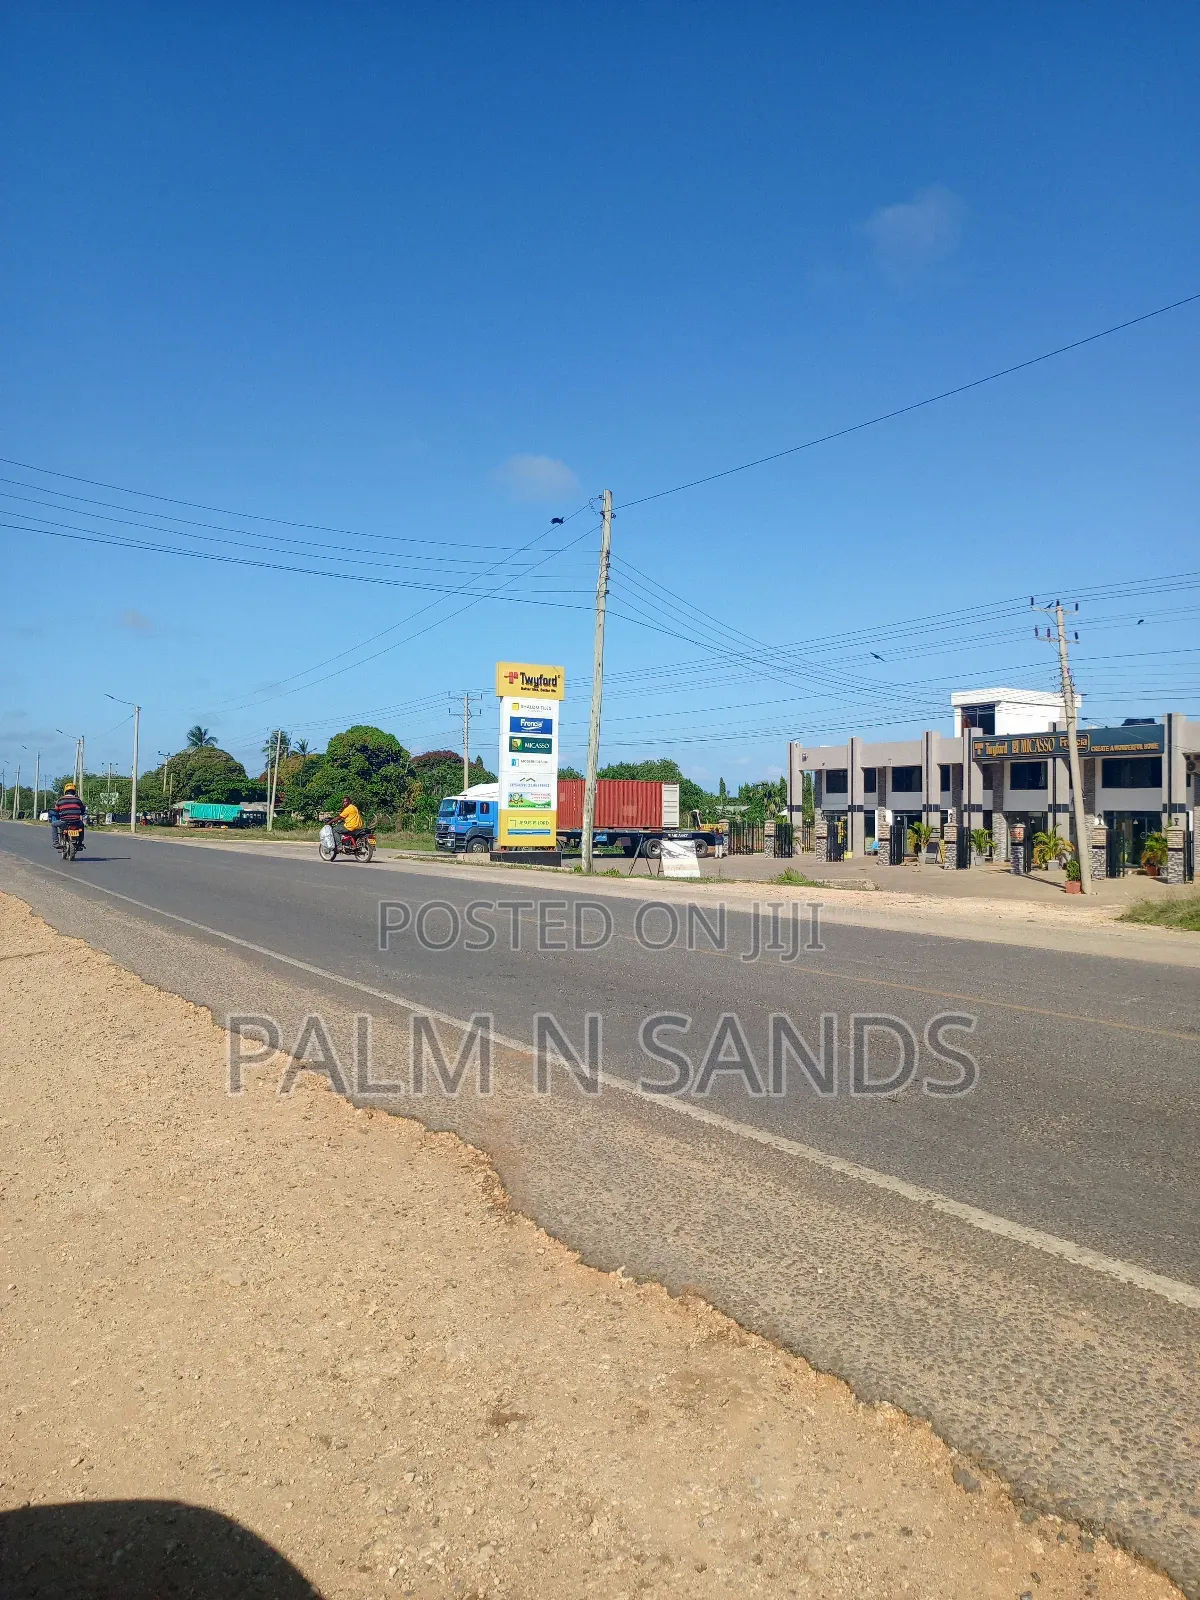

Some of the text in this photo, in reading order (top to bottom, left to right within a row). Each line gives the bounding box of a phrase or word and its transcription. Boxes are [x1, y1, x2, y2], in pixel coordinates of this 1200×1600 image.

[520, 672, 558, 688] Twyford
[1020, 737, 1056, 753] MICASSO
[1059, 737, 1088, 747] Frcia
[1090, 745, 1110, 753] CREATE
